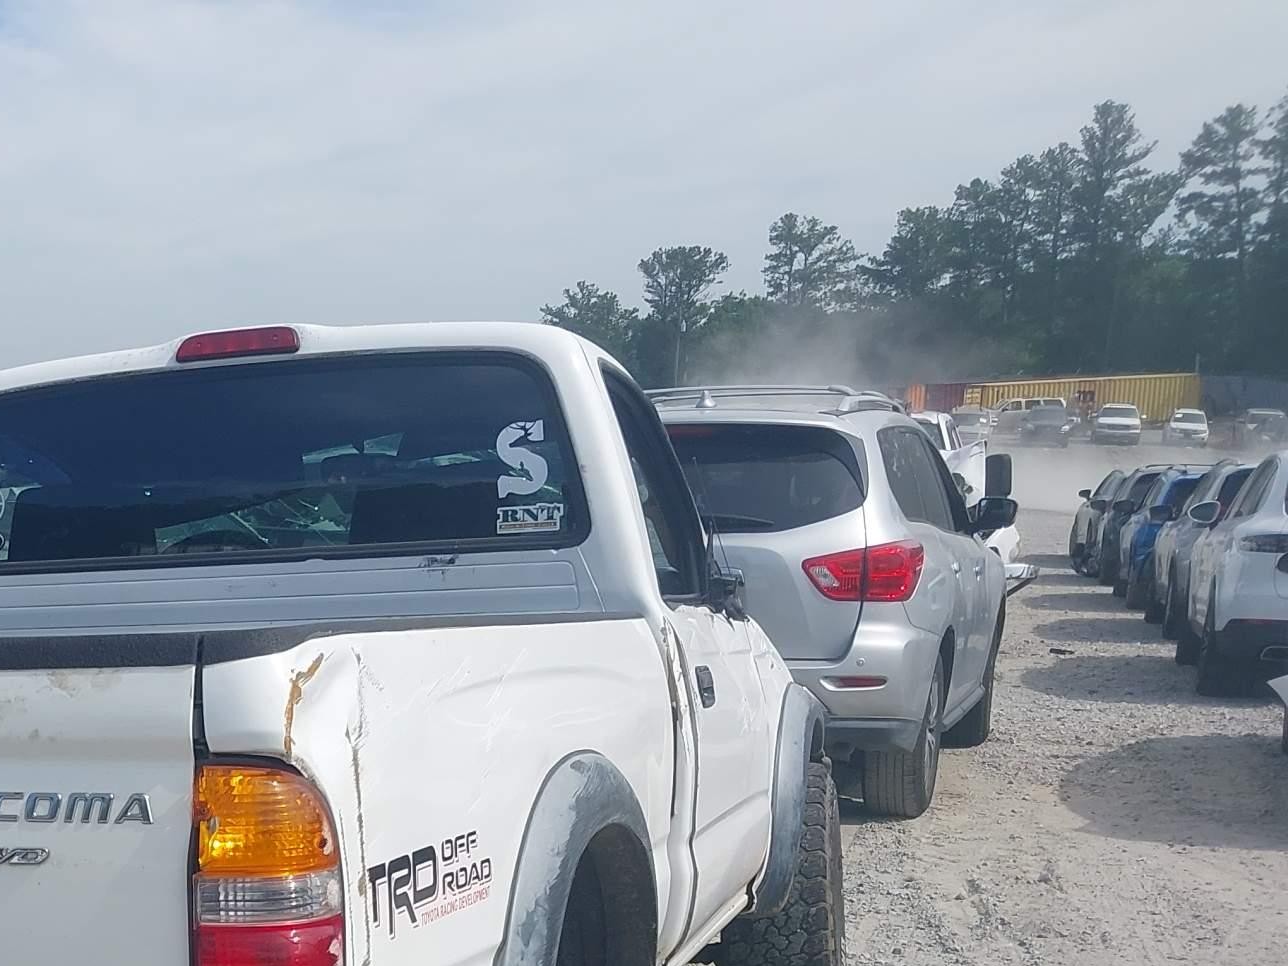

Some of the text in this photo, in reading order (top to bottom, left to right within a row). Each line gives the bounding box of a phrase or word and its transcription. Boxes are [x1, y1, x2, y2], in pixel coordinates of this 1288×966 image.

[497, 419, 548, 499] S
[499, 504, 560, 523] RNT
[441, 830, 478, 866] OFF
[367, 845, 439, 940] TRD
[442, 858, 492, 898] ROAD
